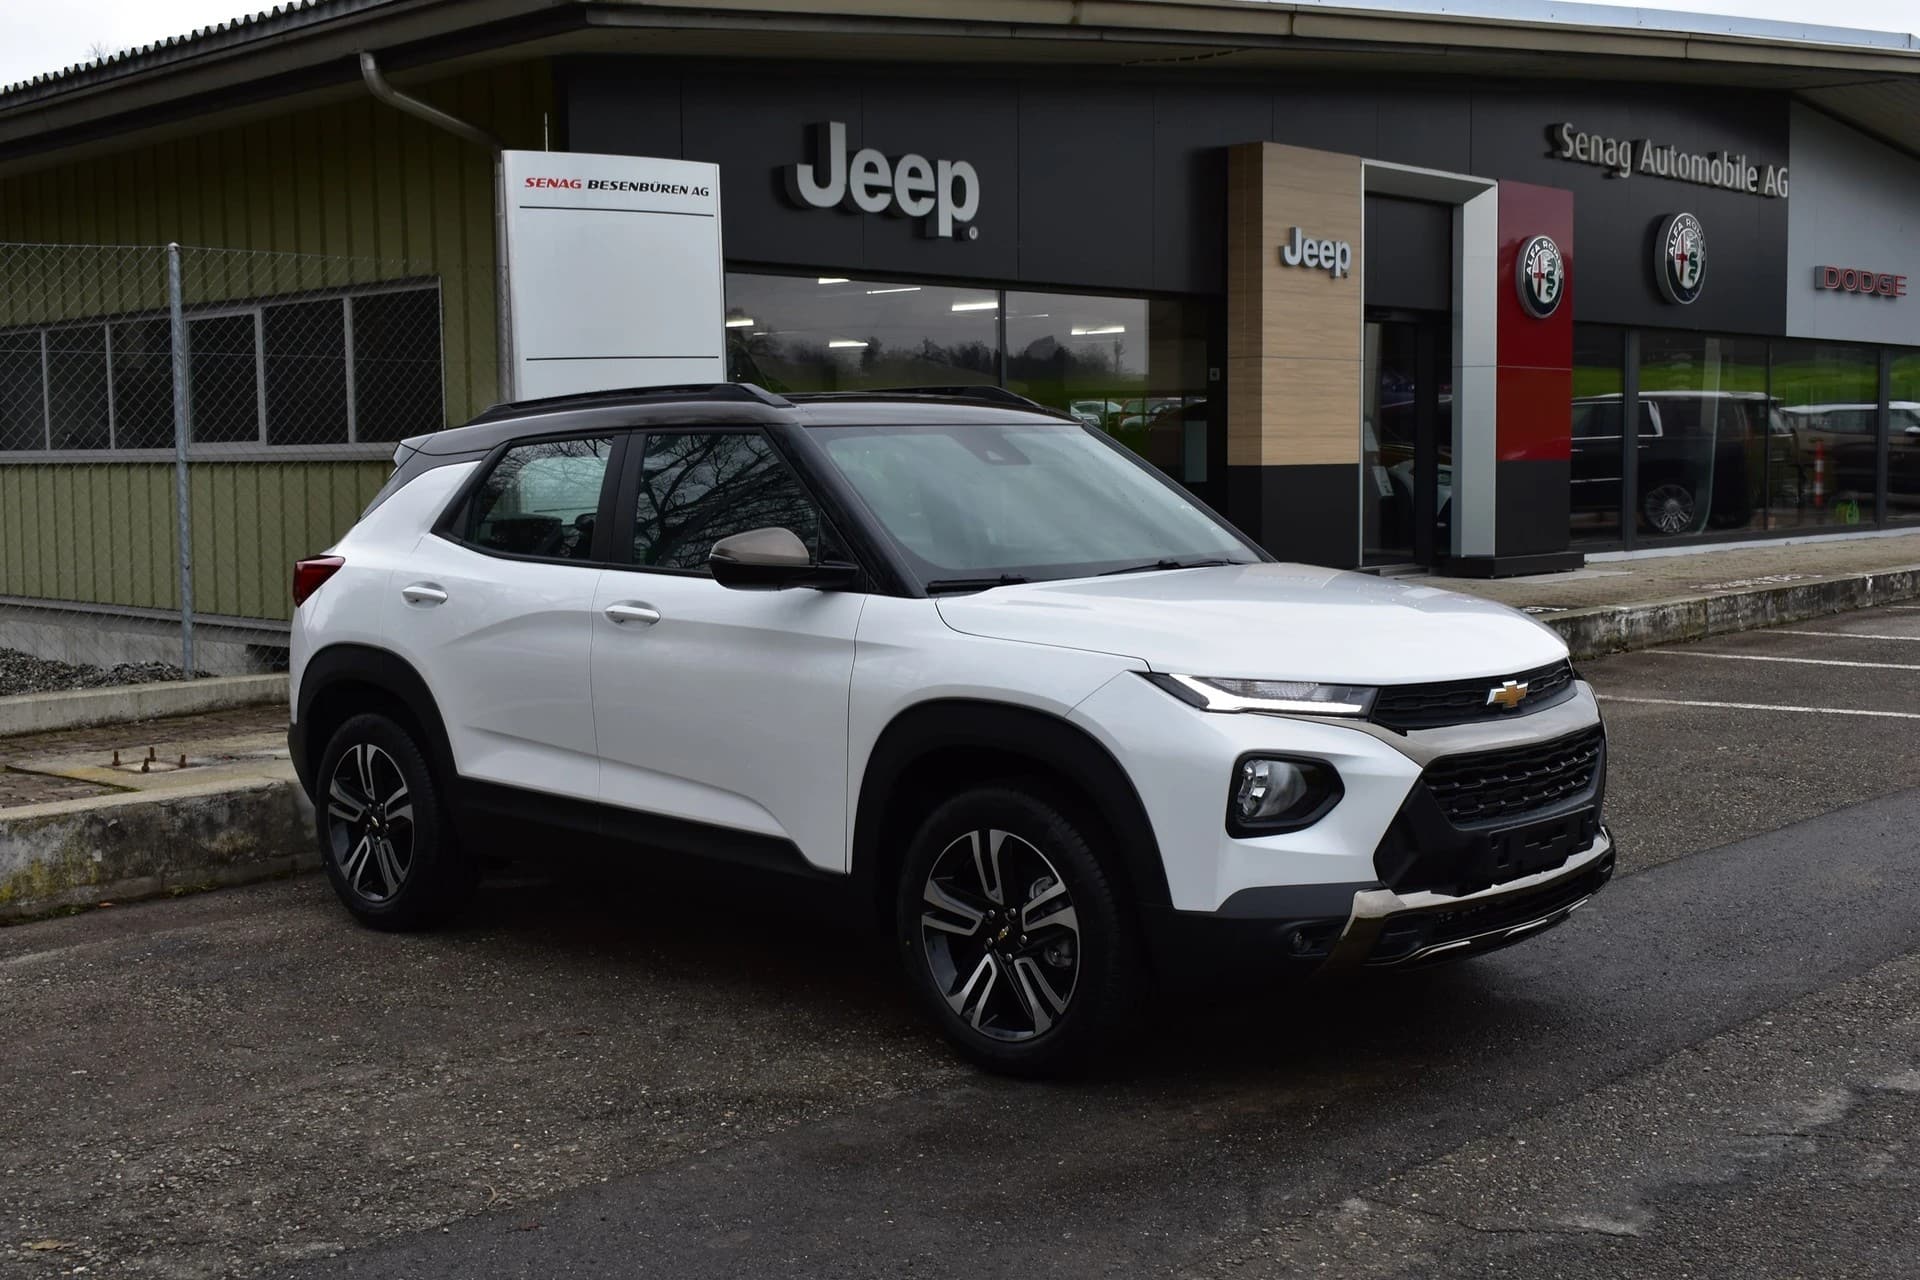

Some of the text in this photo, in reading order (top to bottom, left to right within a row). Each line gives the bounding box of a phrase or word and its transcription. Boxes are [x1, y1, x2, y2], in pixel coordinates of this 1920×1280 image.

[1562, 122, 1789, 198] Senag Automobile AG
[525, 177, 710, 197] SENAG BESENBÜREN AG
[797, 121, 980, 237] Jeep
[1284, 227, 1352, 277] Jeep
[1668, 222, 1683, 256] ALFA
[1526, 243, 1540, 275] ALFA
[1823, 266, 1908, 297] DODGE
